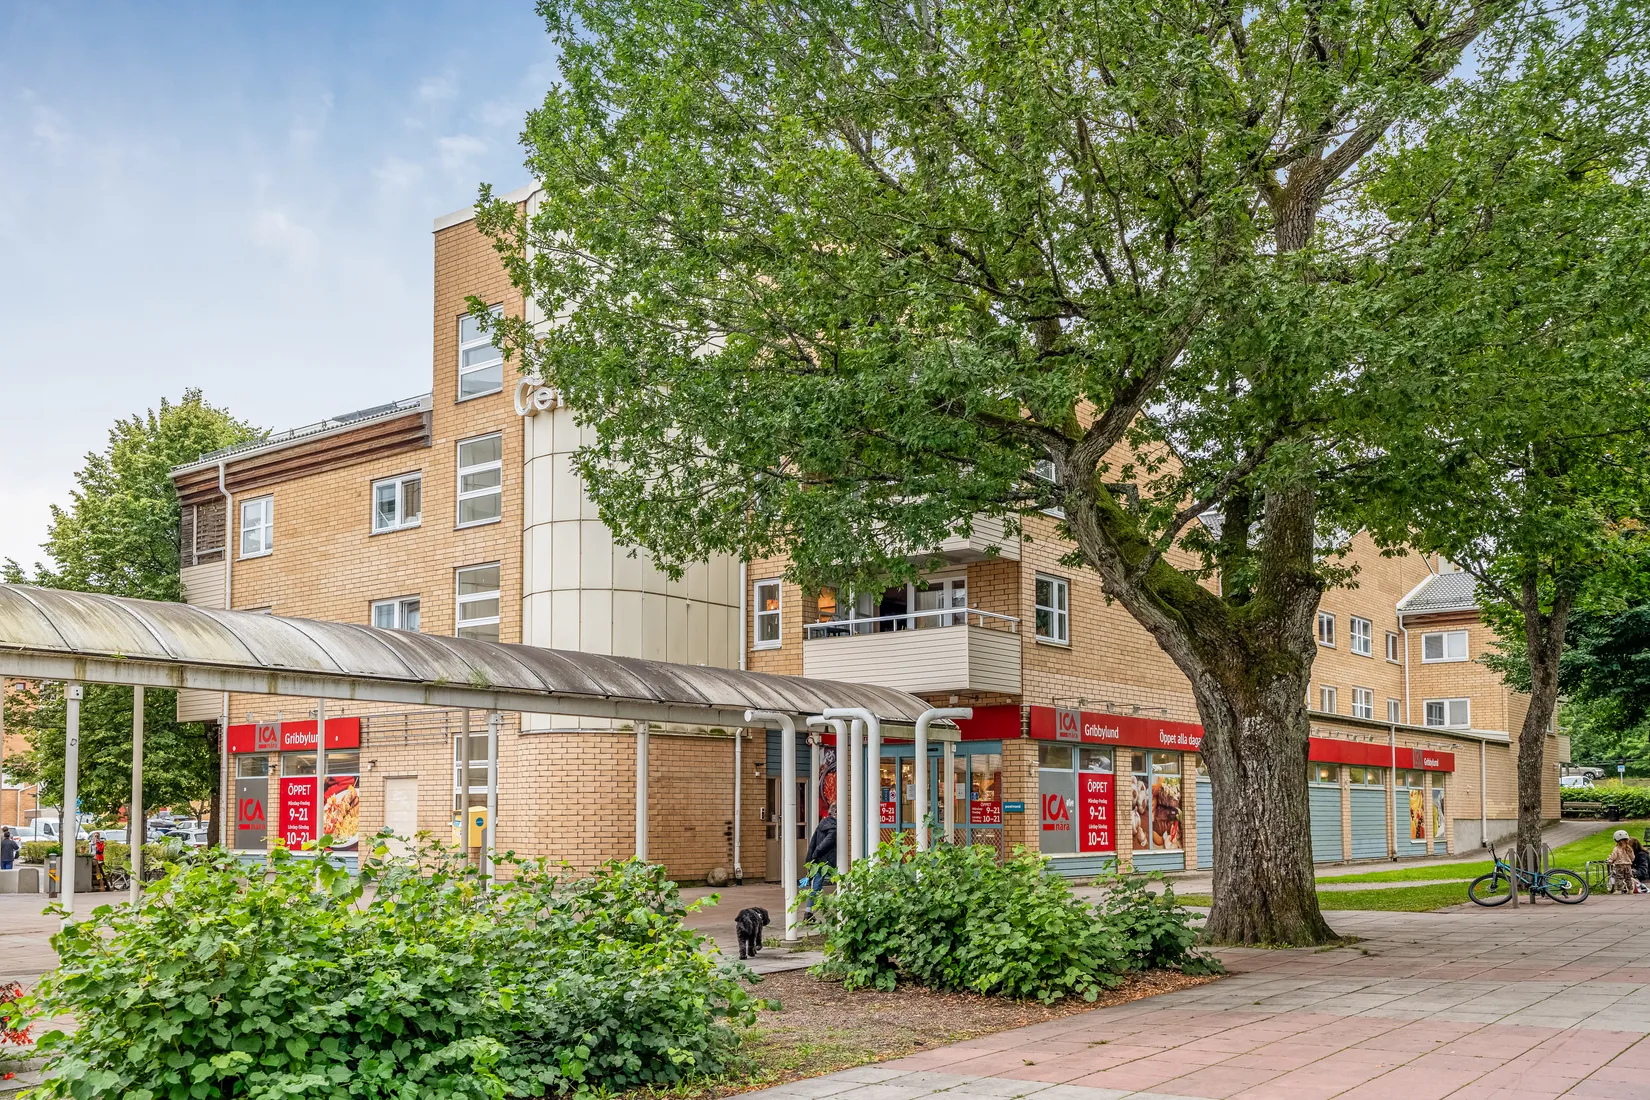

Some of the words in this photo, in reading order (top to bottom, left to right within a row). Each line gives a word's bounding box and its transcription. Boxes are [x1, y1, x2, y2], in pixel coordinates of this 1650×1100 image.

[1060, 711, 1077, 731] ICA
[259, 726, 277, 743] ICA
[1084, 723, 1119, 740] Gribbylund
[1159, 729, 1177, 746] Öppet
[1177, 733, 1188, 745] alla
[1188, 734, 1202, 748] daga
[285, 732, 318, 746] Gribbylun
[288, 783, 311, 795] ÖPPET
[1087, 779, 1107, 793] ÖPPET
[239, 798, 265, 821] ICA
[1042, 793, 1070, 821] ICA
[1089, 806, 1106, 820] 9-21
[289, 808, 308, 821] 9-21
[983, 815, 1000, 823] 10-21
[1055, 821, 1070, 831] nära
[286, 832, 310, 845] 10-21
[1088, 832, 1109, 846] 10-21
